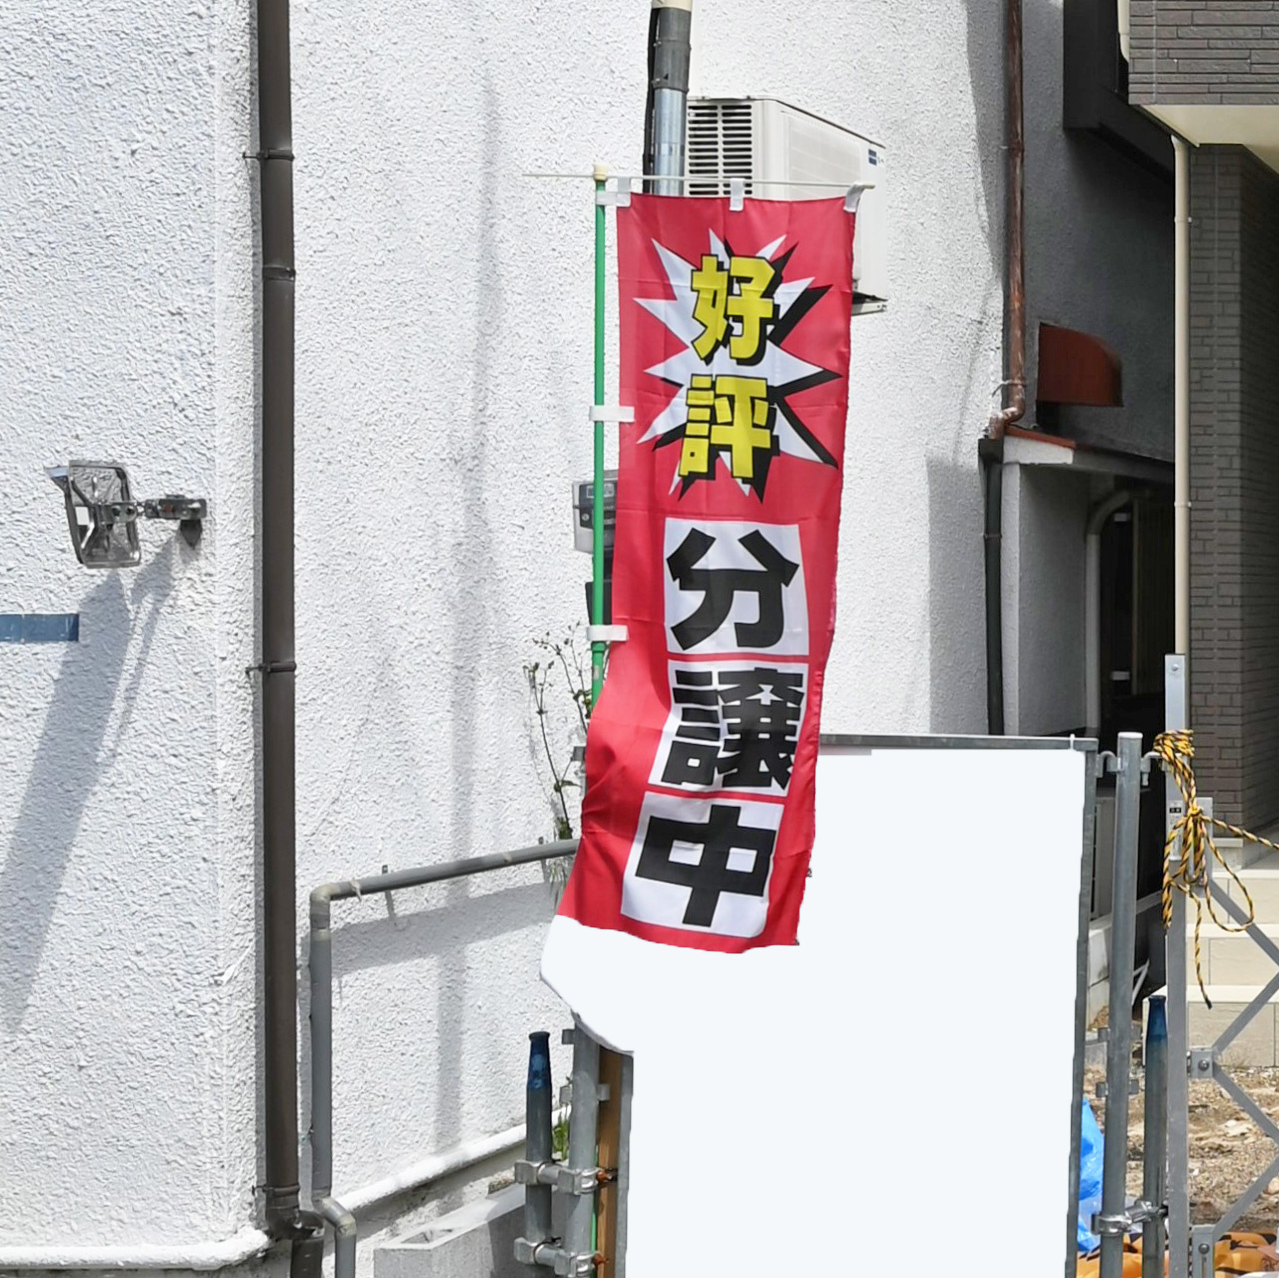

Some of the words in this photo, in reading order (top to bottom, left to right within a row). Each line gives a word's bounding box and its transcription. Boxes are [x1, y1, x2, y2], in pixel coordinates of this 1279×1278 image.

[679, 254, 774, 480] 好評
[633, 528, 805, 926] 分譲中
